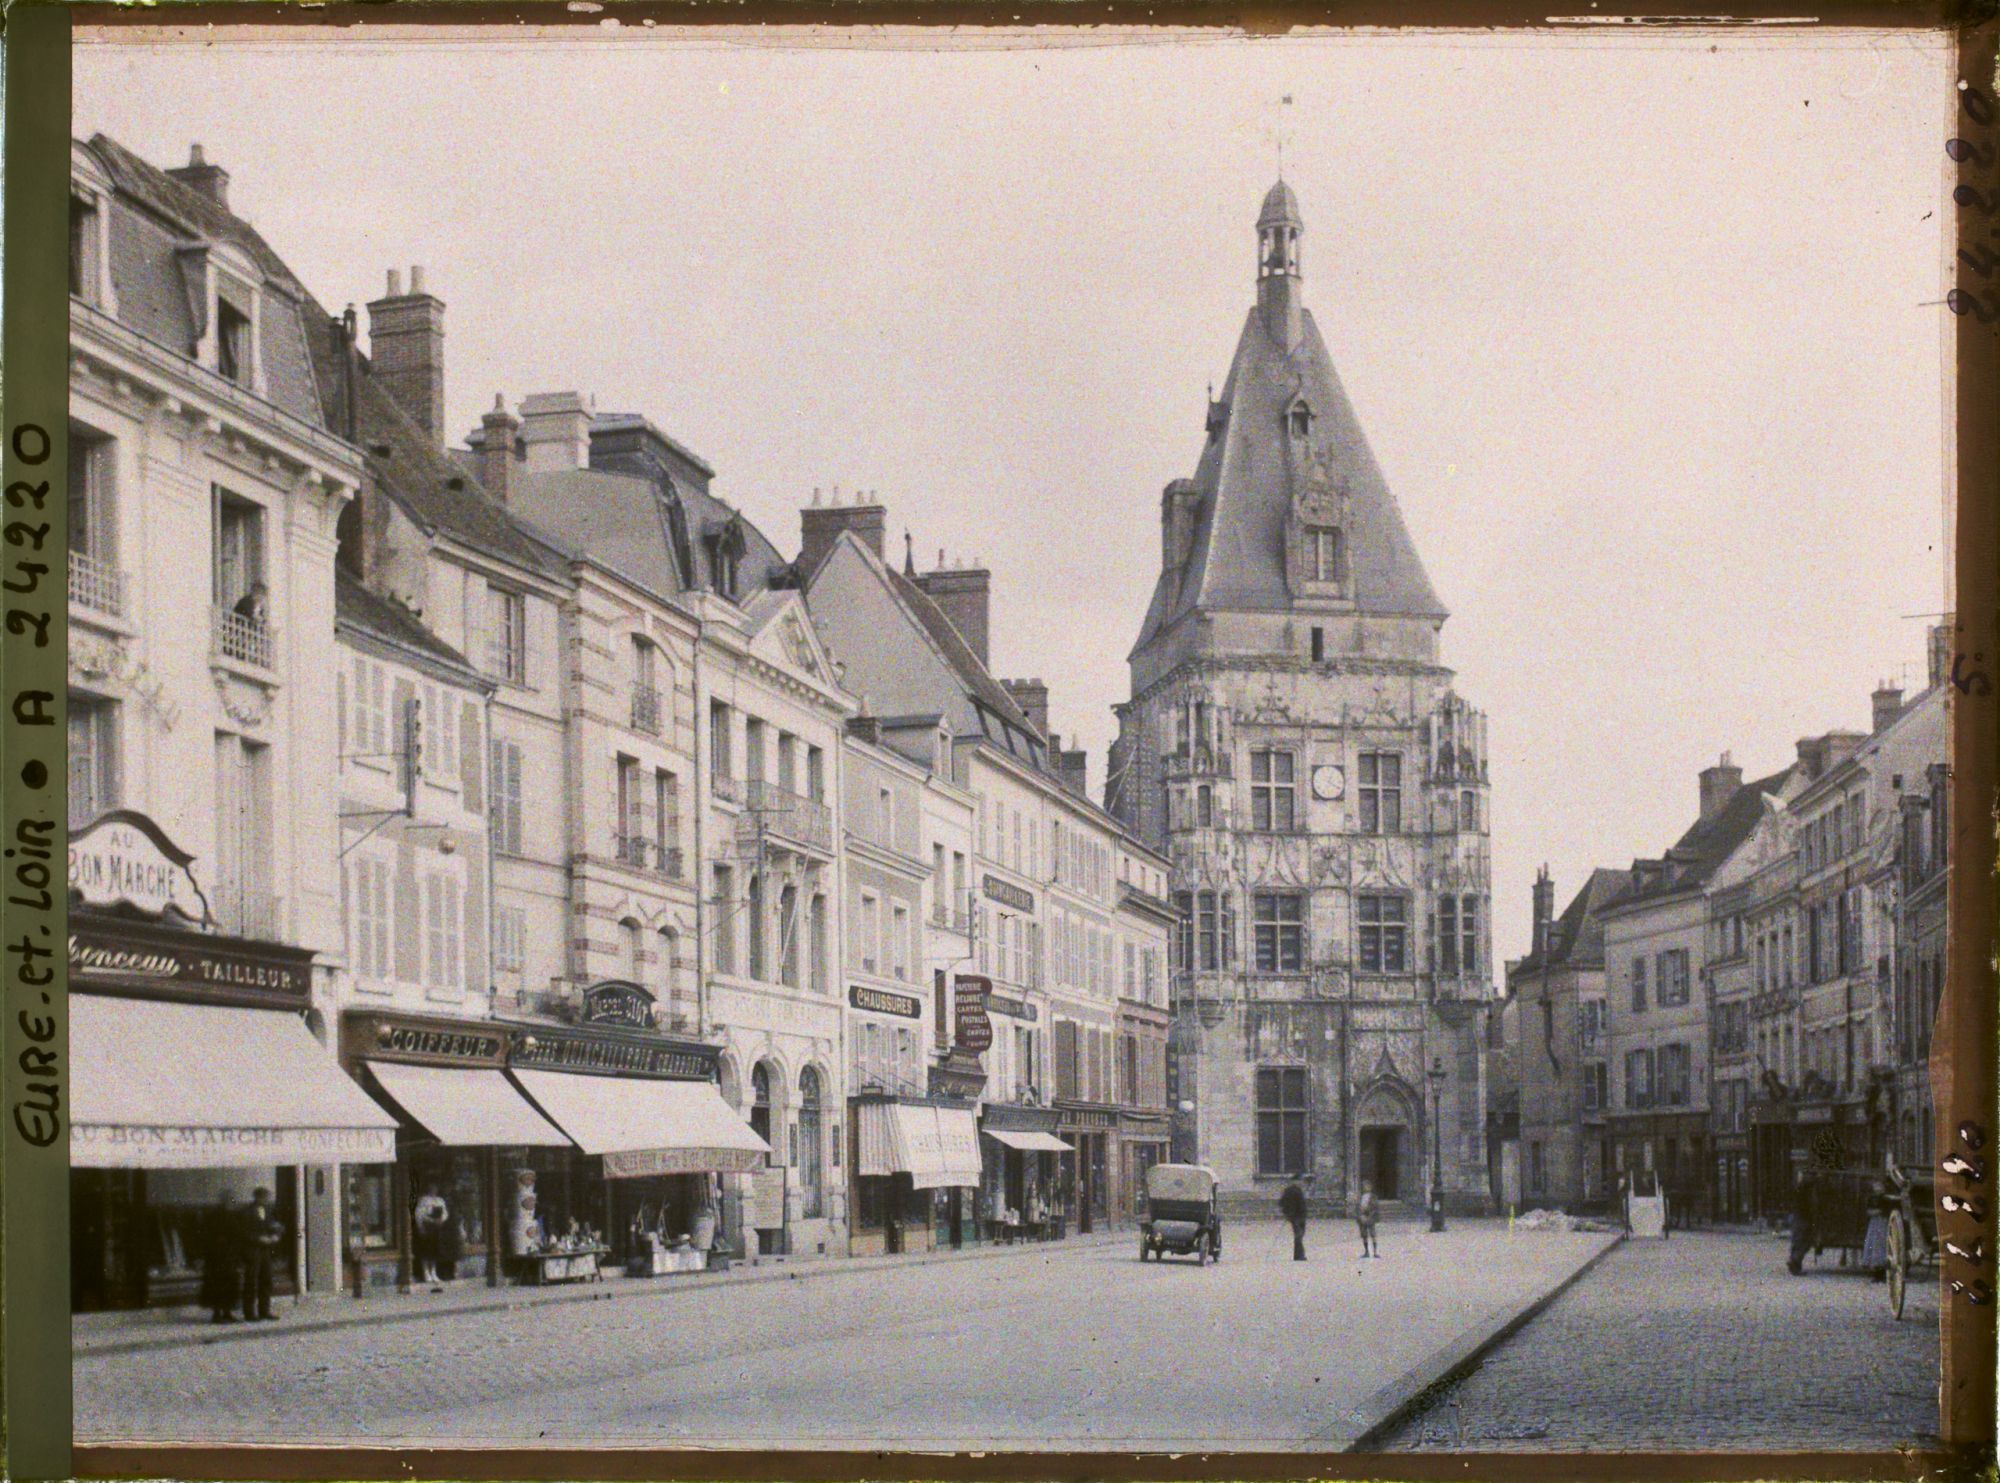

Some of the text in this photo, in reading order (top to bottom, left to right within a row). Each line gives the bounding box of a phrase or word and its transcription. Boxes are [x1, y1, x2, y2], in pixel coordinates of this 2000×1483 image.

[2, 423, 51, 648] 24220
[12, 690, 56, 726] A
[111, 831, 134, 848] AU
[68, 848, 103, 886] BON
[201, 959, 292, 990] TAILLEUR
[856, 987, 914, 1016] CHAUSSURES
[391, 1028, 488, 1057] COIFFEUR
[110, 1127, 166, 1145] BON
